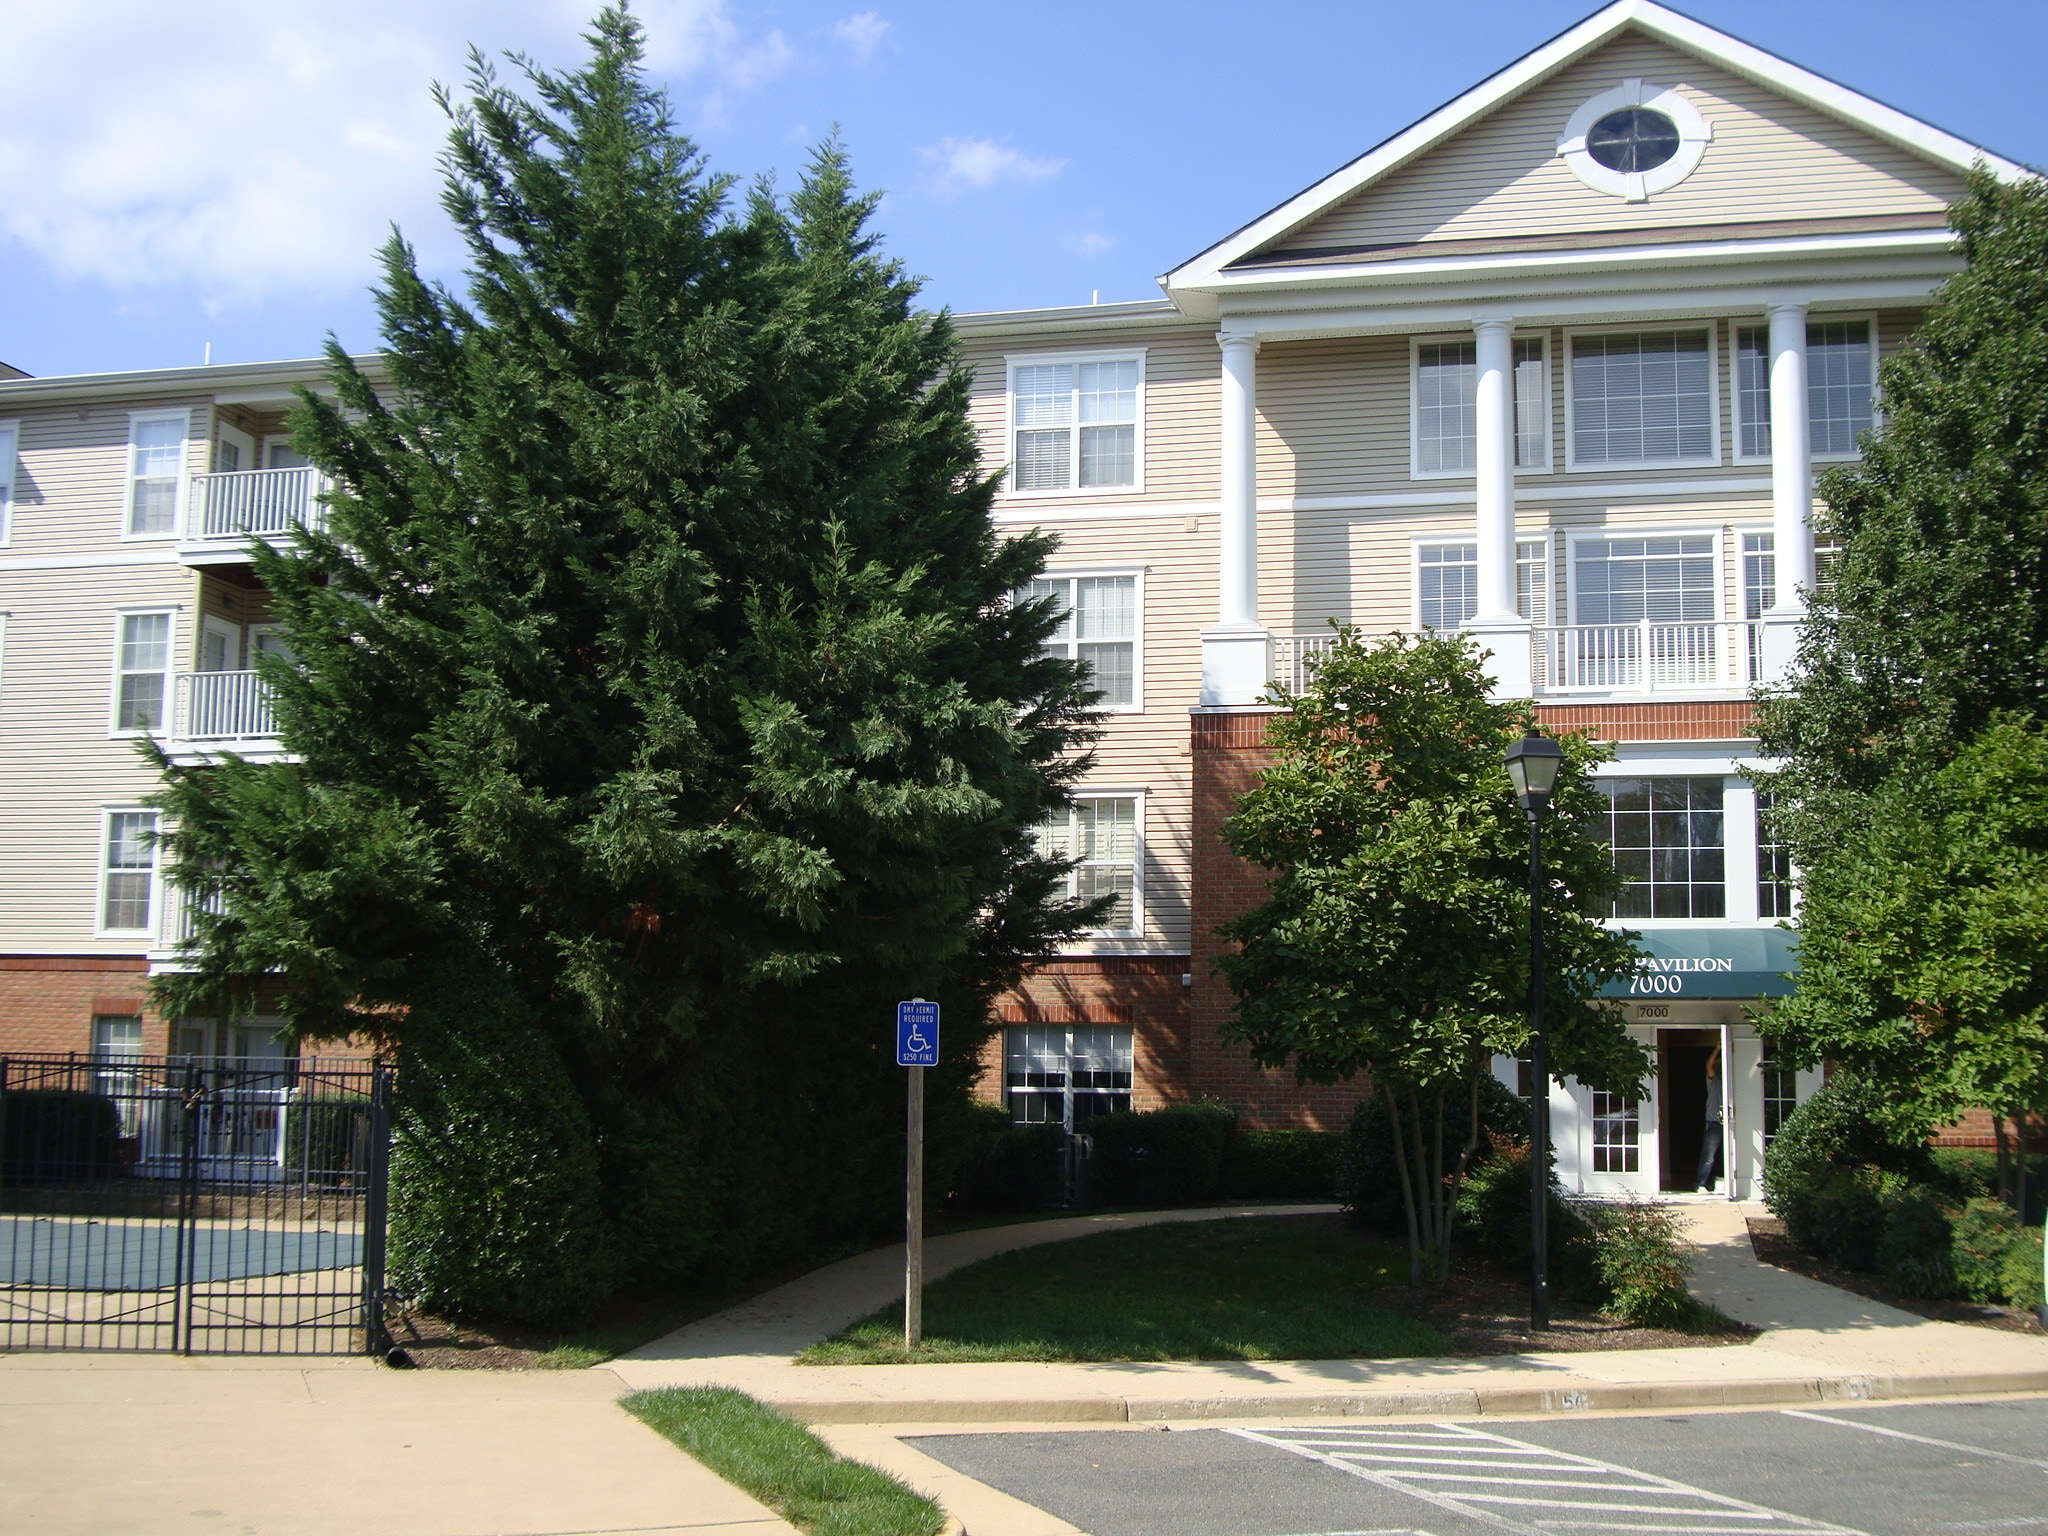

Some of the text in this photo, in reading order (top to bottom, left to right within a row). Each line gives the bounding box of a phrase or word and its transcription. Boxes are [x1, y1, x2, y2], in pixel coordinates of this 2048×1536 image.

[1632, 958, 1733, 972] PAVILION
[1630, 975, 1682, 994] 7000
[916, 1006, 934, 1014] PERMIT
[1639, 1007, 1669, 1018] 7000
[903, 1015, 934, 1023] REQUIRED
[903, 1053, 933, 1061] $250 FINE
